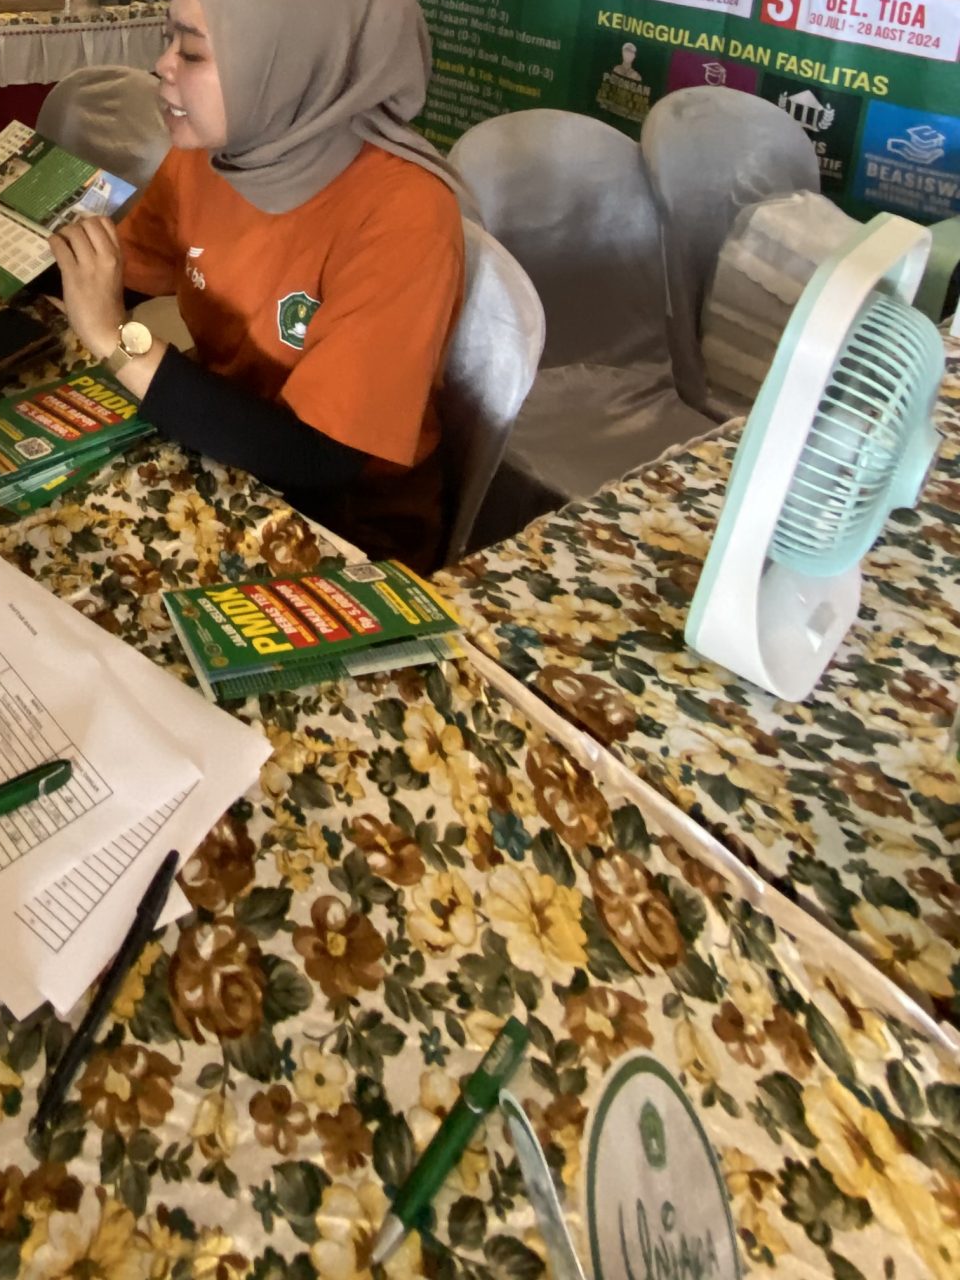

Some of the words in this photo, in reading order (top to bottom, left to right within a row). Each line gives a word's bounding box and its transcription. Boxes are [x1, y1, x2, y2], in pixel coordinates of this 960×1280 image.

[809, 13, 823, 26] 30
[825, 16, 845, 32] JULI
[857, 23, 871, 36] 28
[875, 26, 905, 42] AGST
[908, 31, 940, 50] 2024
[598, 10, 725, 53] KEUNGGULAN
[728, 38, 770, 65] DAN
[776, 53, 889, 96] FASILITAS
[67, 375, 138, 420] PMDK
[197, 598, 227, 624] SELEKSI
[250, 593, 266, 606] TES
[205, 587, 294, 654] PMDK
[221, 624, 247, 647] JALUR
[301, 608, 334, 634] PAKAI
